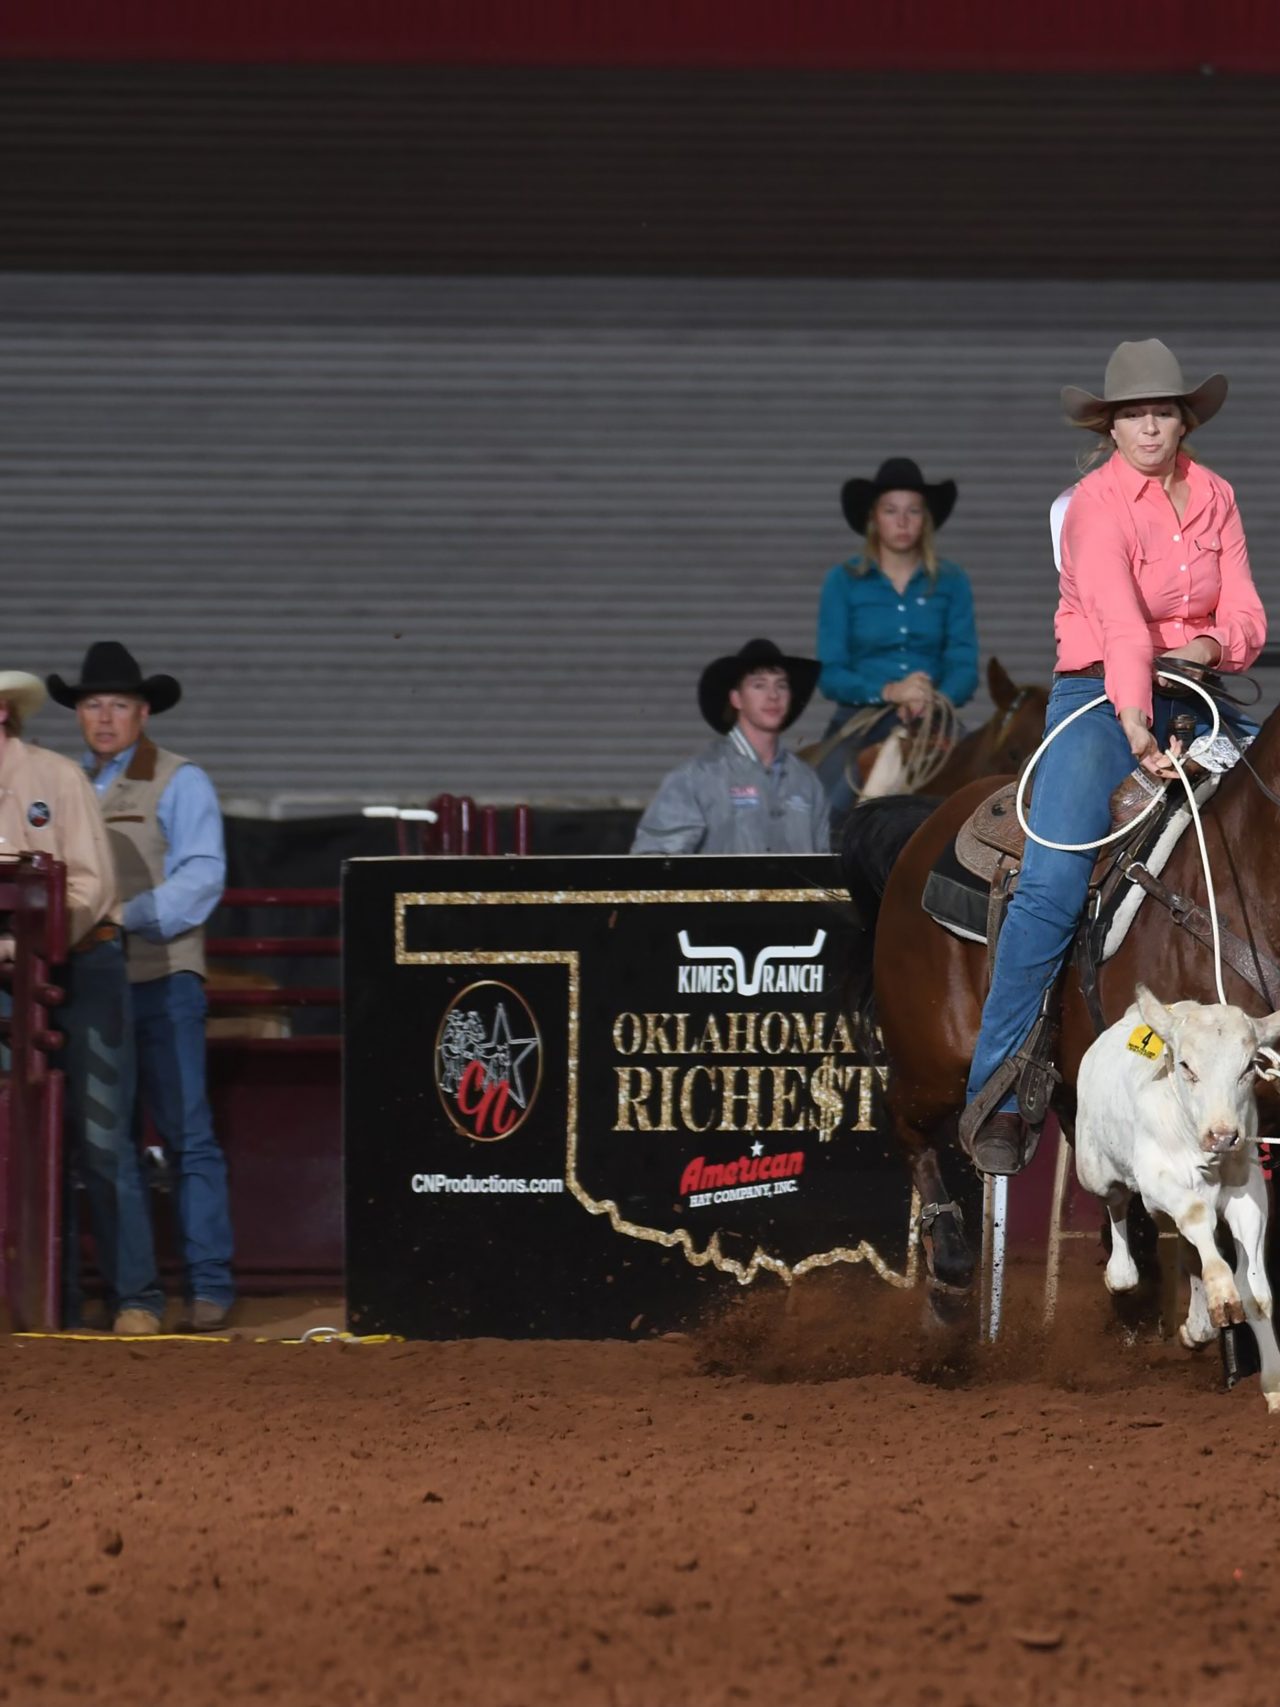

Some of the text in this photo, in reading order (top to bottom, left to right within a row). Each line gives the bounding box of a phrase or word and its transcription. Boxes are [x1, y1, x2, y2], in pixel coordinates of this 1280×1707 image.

[677, 964, 824, 993] KIMES RANCH
[1141, 1031, 1154, 1050] 4
[411, 1173, 564, 1193] CNProductions.com
[680, 1151, 805, 1195] American
[689, 1192, 713, 1208] HAT
[773, 1180, 799, 1195] INC.
